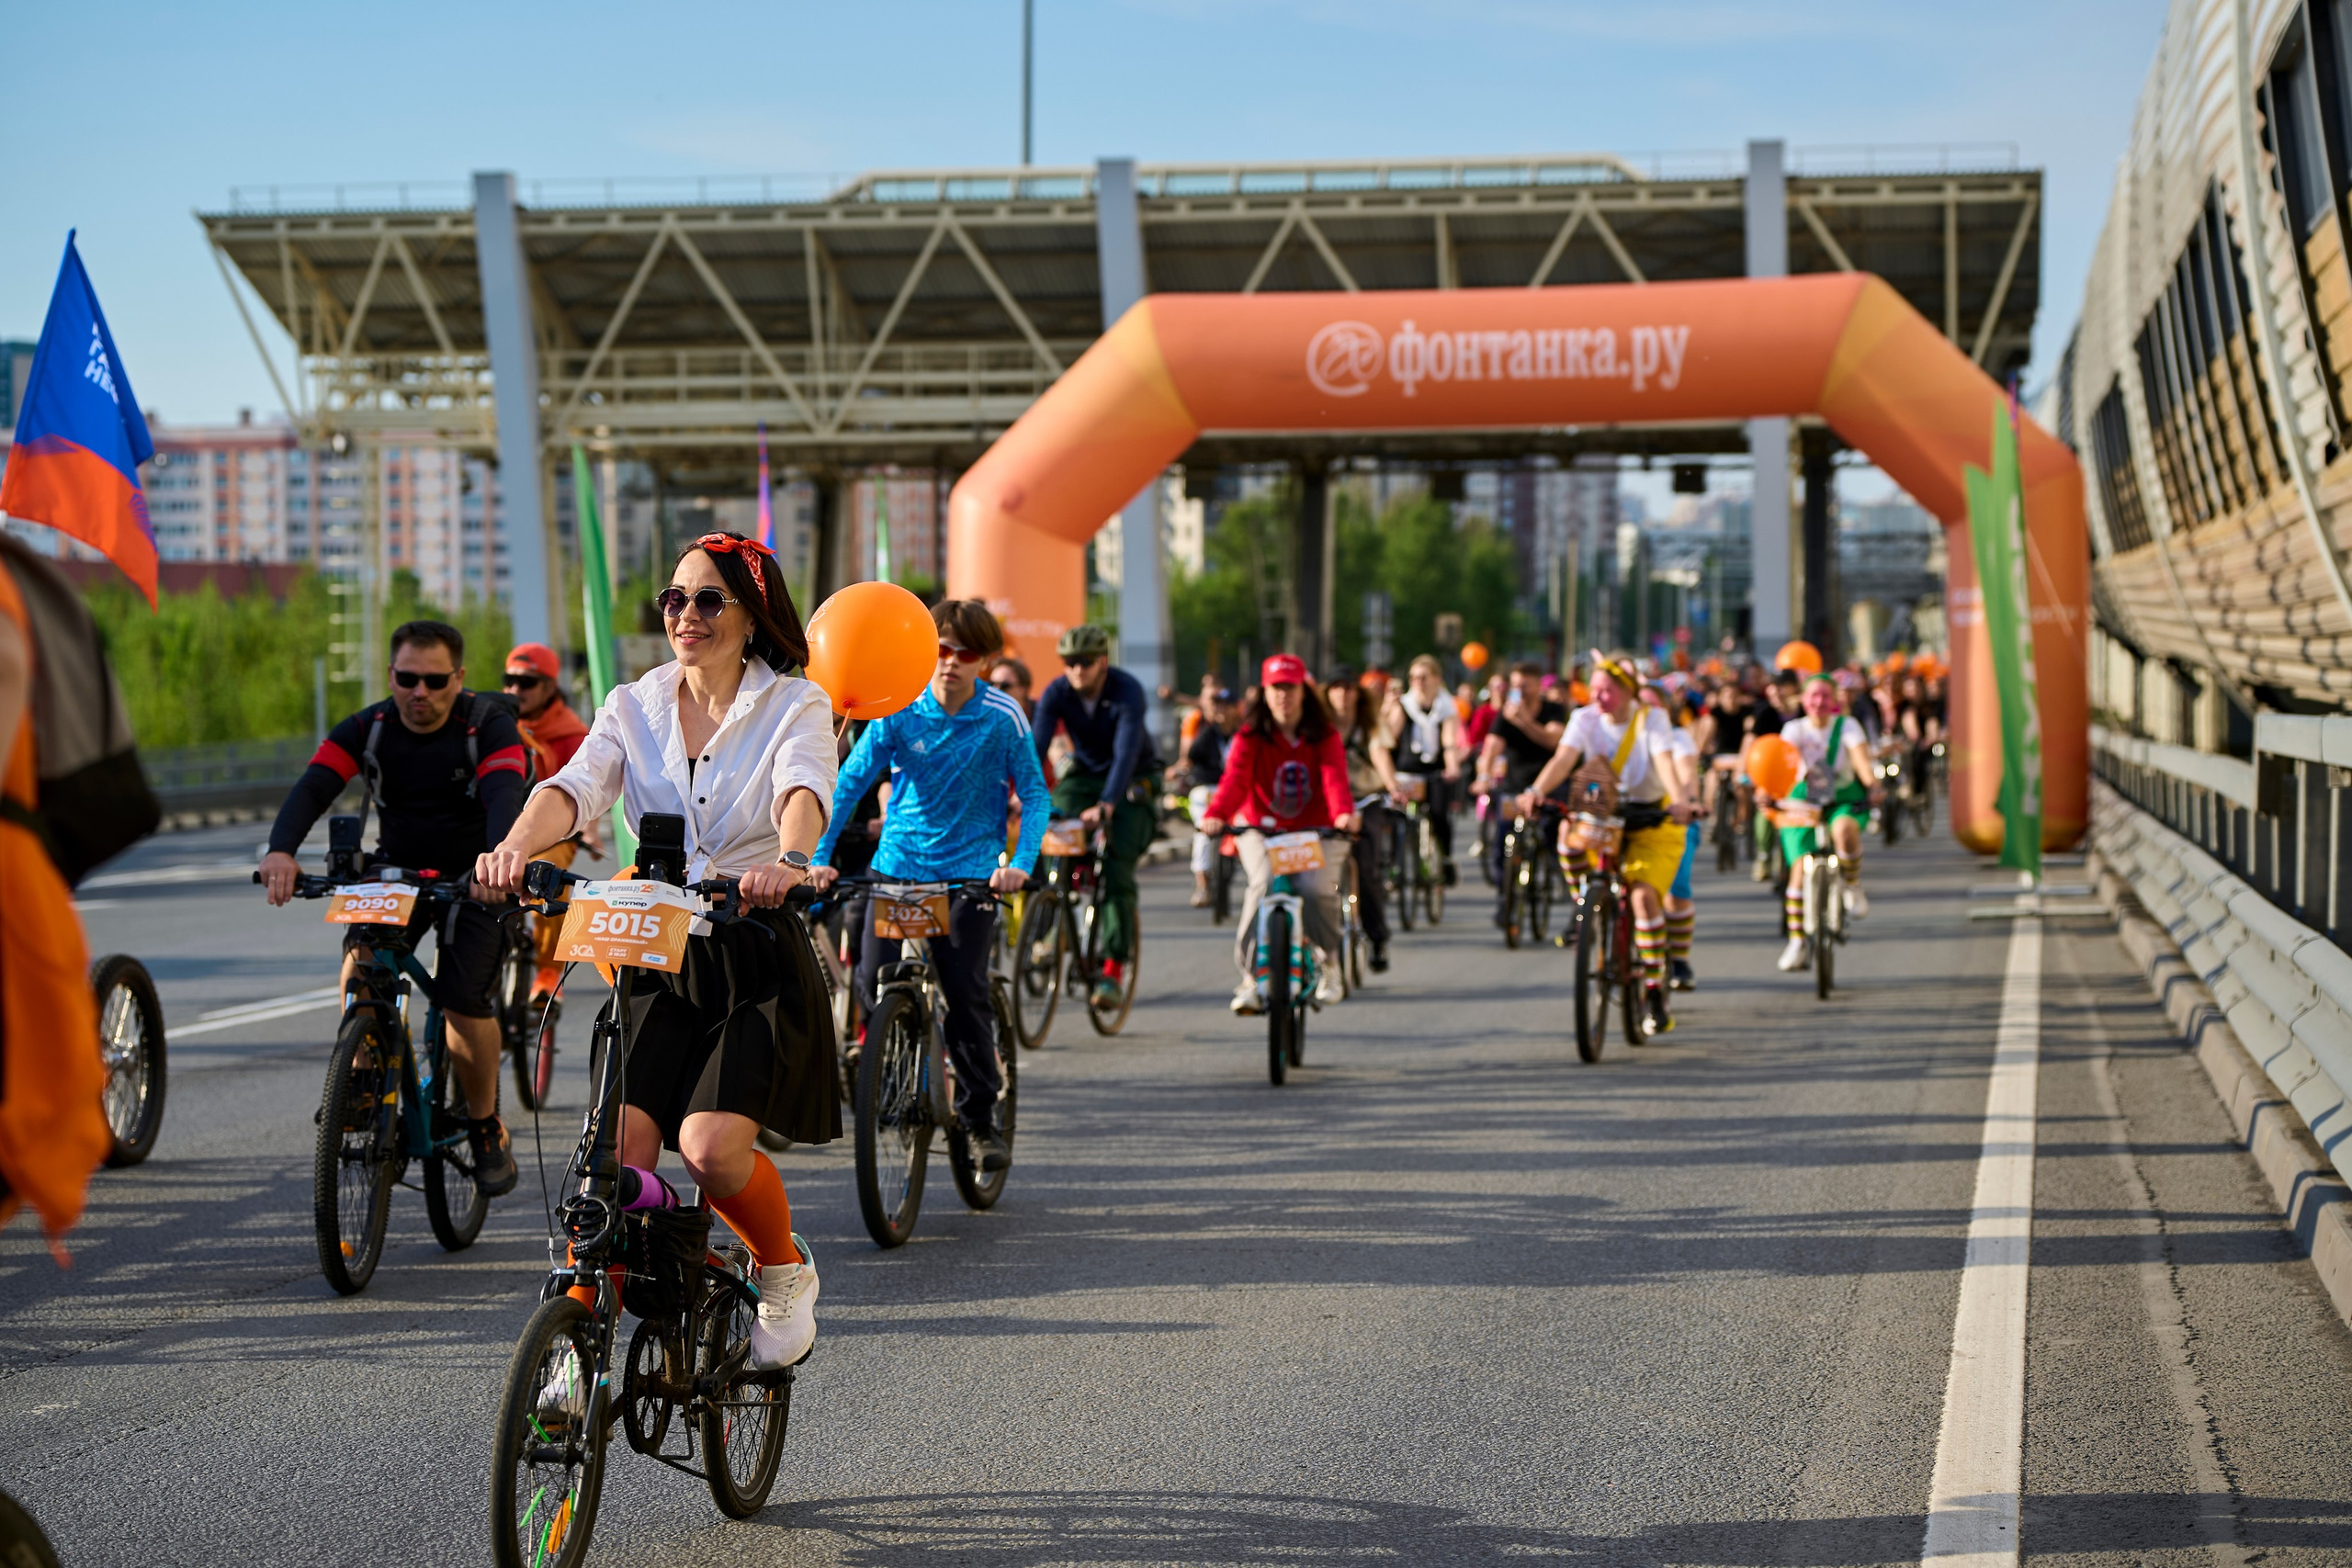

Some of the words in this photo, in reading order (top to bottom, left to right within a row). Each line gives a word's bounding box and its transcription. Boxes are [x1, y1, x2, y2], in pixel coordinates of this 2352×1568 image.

[1388, 319, 1690, 398] фонтанка.ру
[344, 897, 398, 911] 9090
[588, 912, 661, 939] 5015
